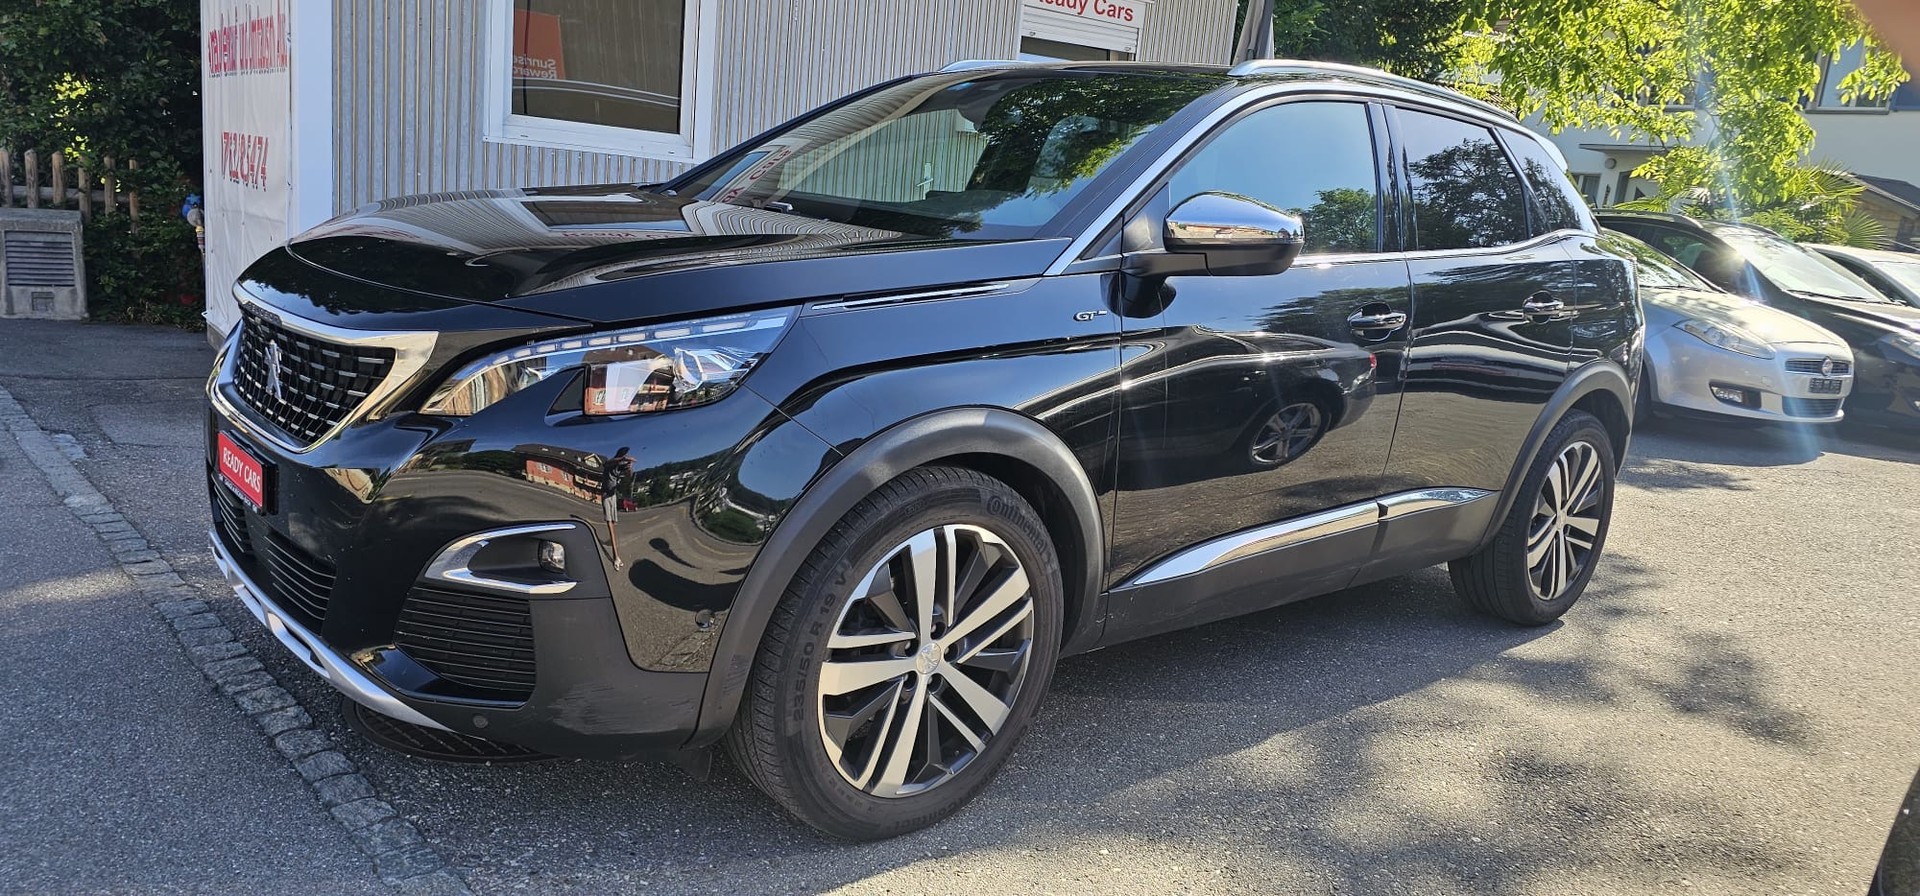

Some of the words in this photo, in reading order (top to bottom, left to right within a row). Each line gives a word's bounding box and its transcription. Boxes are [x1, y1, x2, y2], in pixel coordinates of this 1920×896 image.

[1039, 0, 1088, 15] ady
[1094, 0, 1134, 22] Cars
[222, 446, 244, 478] READY
[244, 465, 261, 494] CARS
